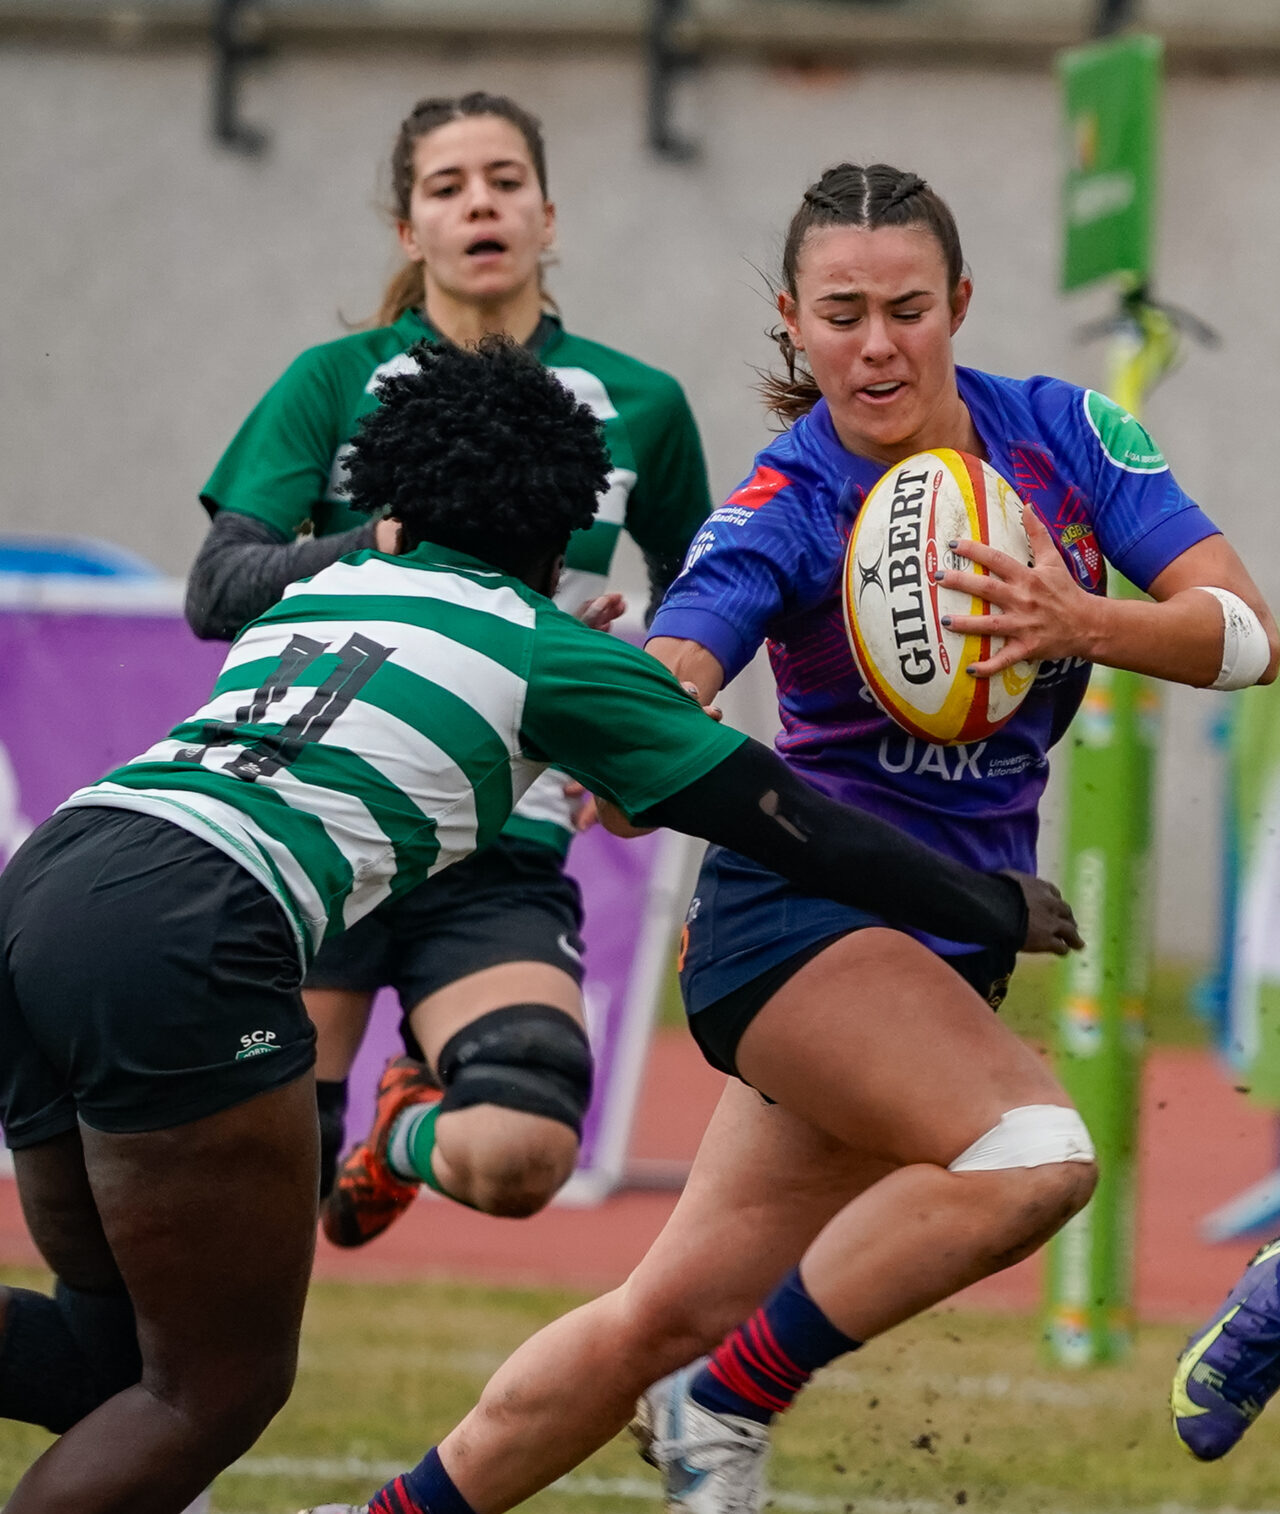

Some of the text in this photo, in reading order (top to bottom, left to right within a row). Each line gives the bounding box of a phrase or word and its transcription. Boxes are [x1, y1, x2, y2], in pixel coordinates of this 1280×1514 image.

[888, 470, 936, 685] GILBERT
[878, 735, 987, 781] UAX
[240, 1030, 276, 1048] SCP
